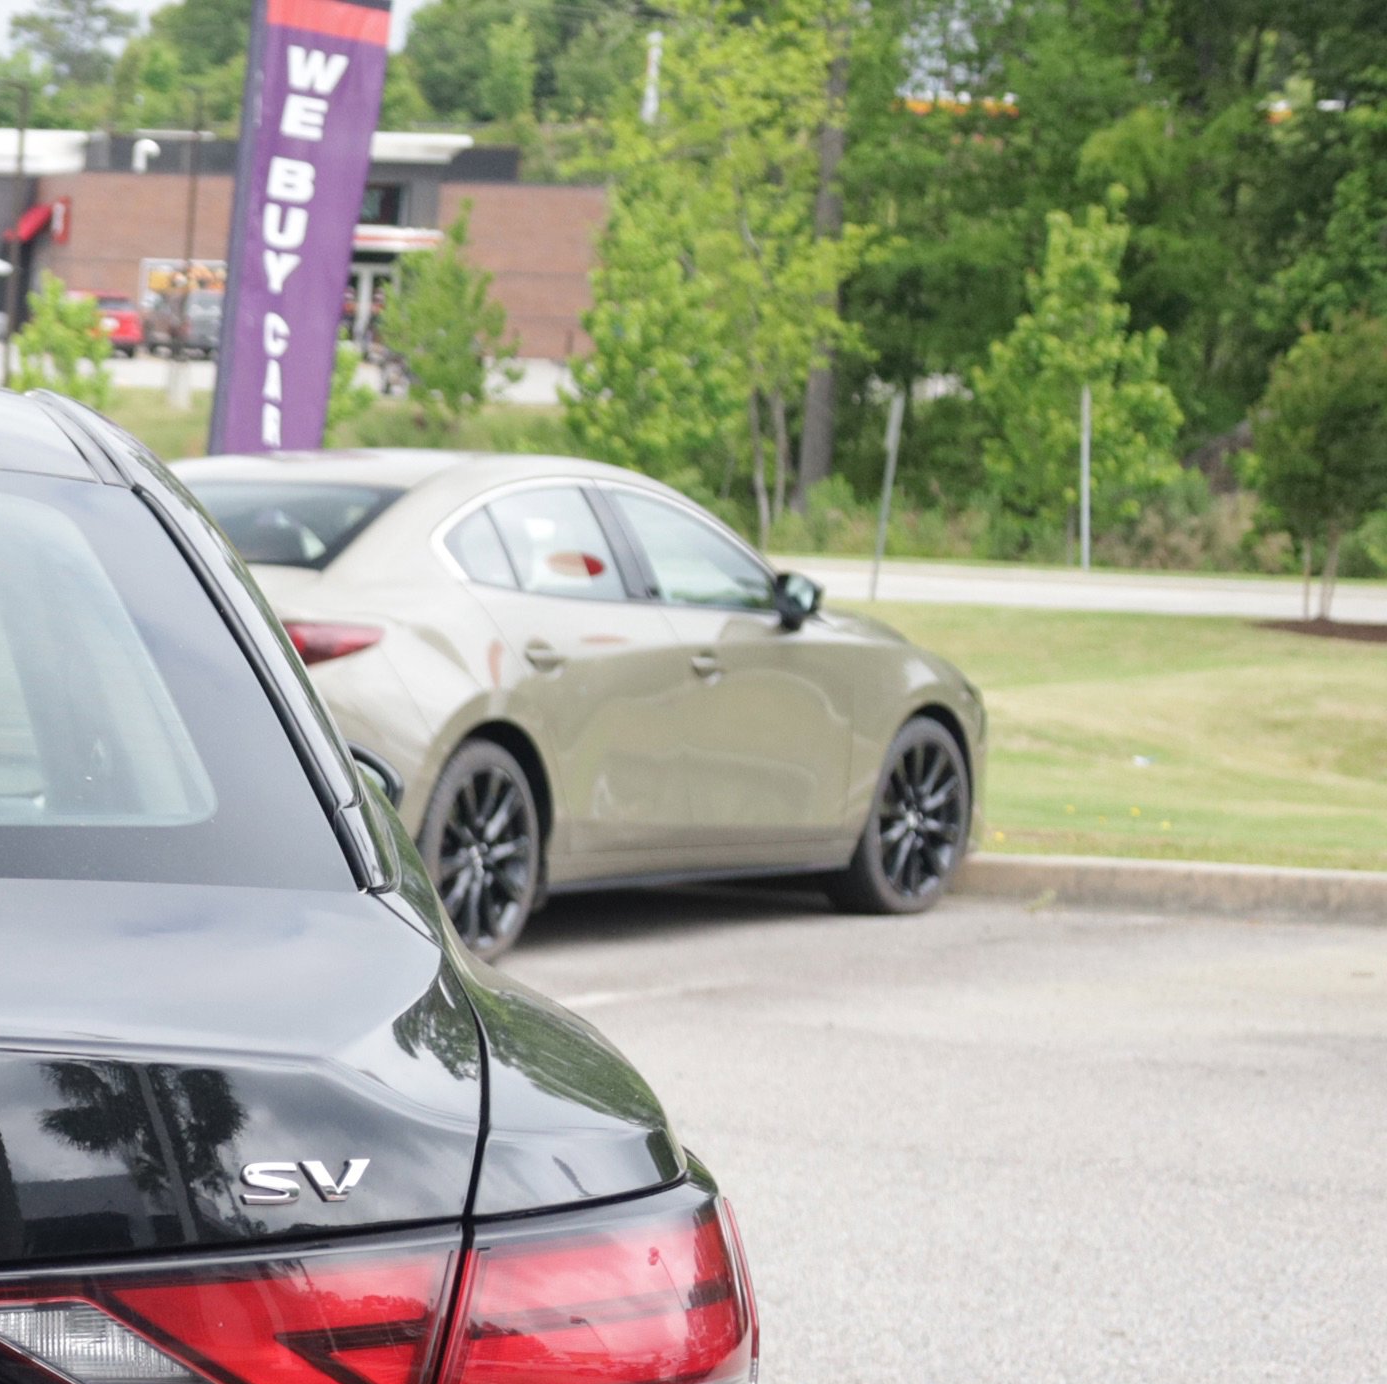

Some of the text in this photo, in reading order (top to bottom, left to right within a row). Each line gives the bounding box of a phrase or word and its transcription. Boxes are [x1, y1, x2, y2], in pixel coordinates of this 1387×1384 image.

[280, 44, 350, 142] WE
[262, 156, 316, 294] BUY
[239, 1158, 371, 1206] SV
